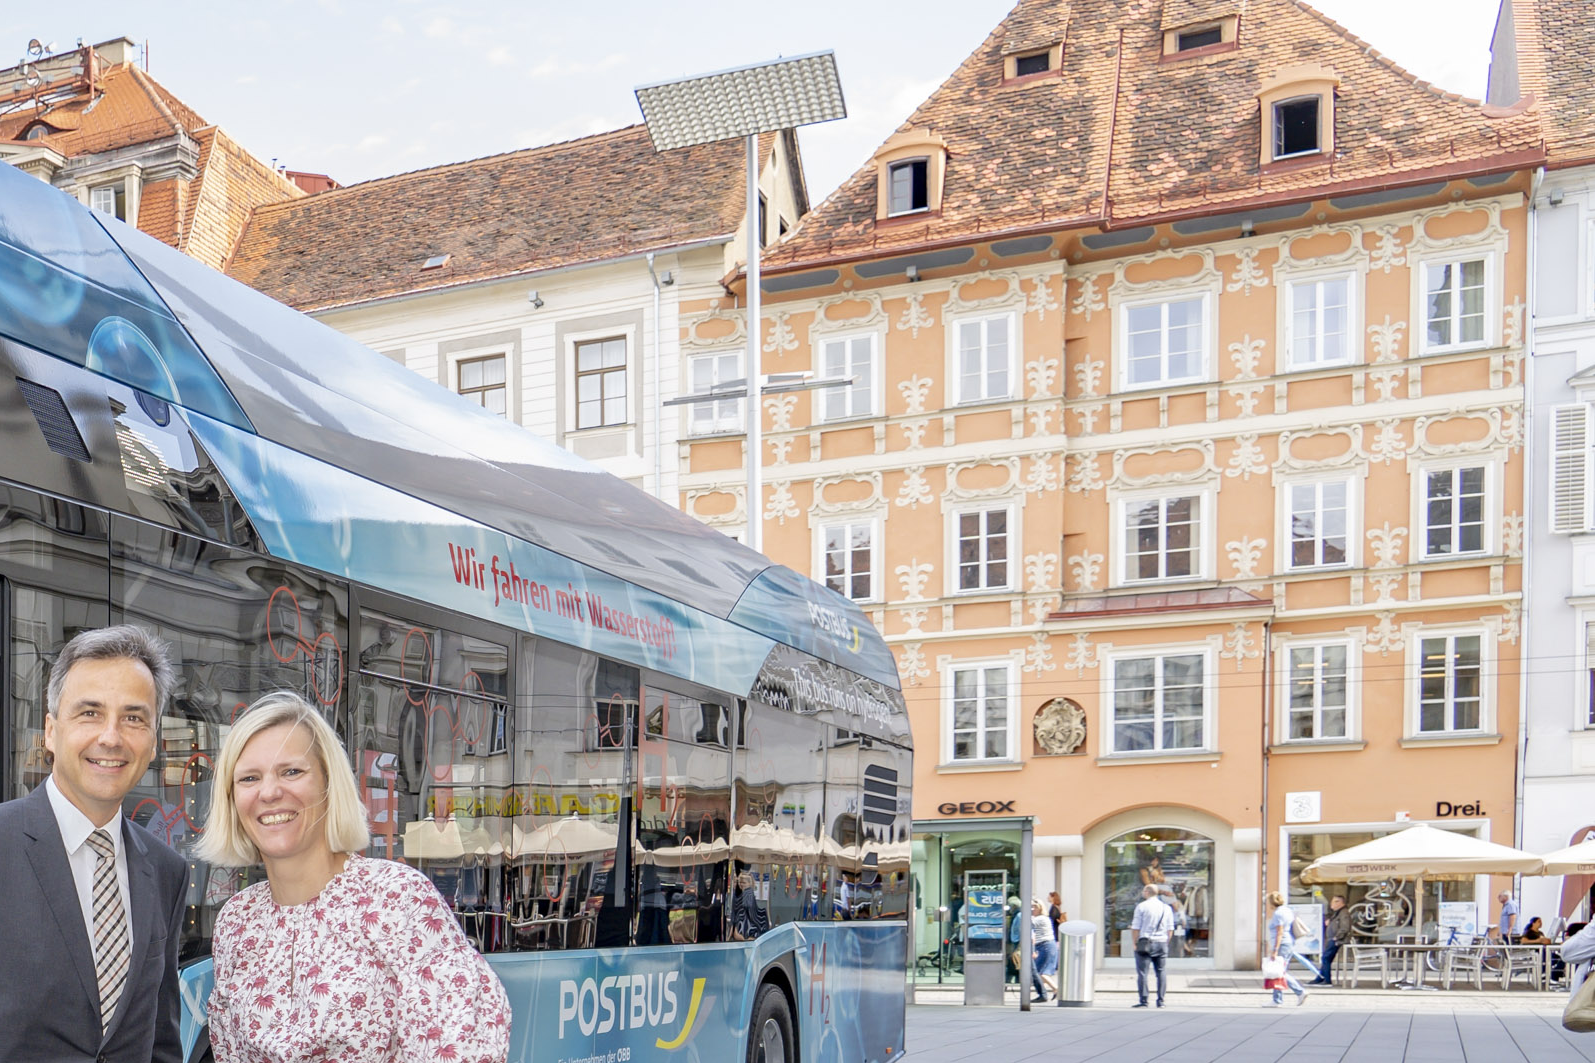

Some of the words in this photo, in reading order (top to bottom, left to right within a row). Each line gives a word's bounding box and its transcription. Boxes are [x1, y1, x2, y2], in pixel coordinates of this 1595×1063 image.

[448, 542, 486, 592] Wir
[491, 555, 552, 613] fahren
[555, 582, 585, 623] mit
[585, 591, 677, 660] Wasserstoff!
[806, 600, 852, 641] POSTBUS
[938, 800, 1016, 816] GEOX
[1436, 800, 1487, 817] Drei.
[558, 970, 679, 1040] POSTBUS
